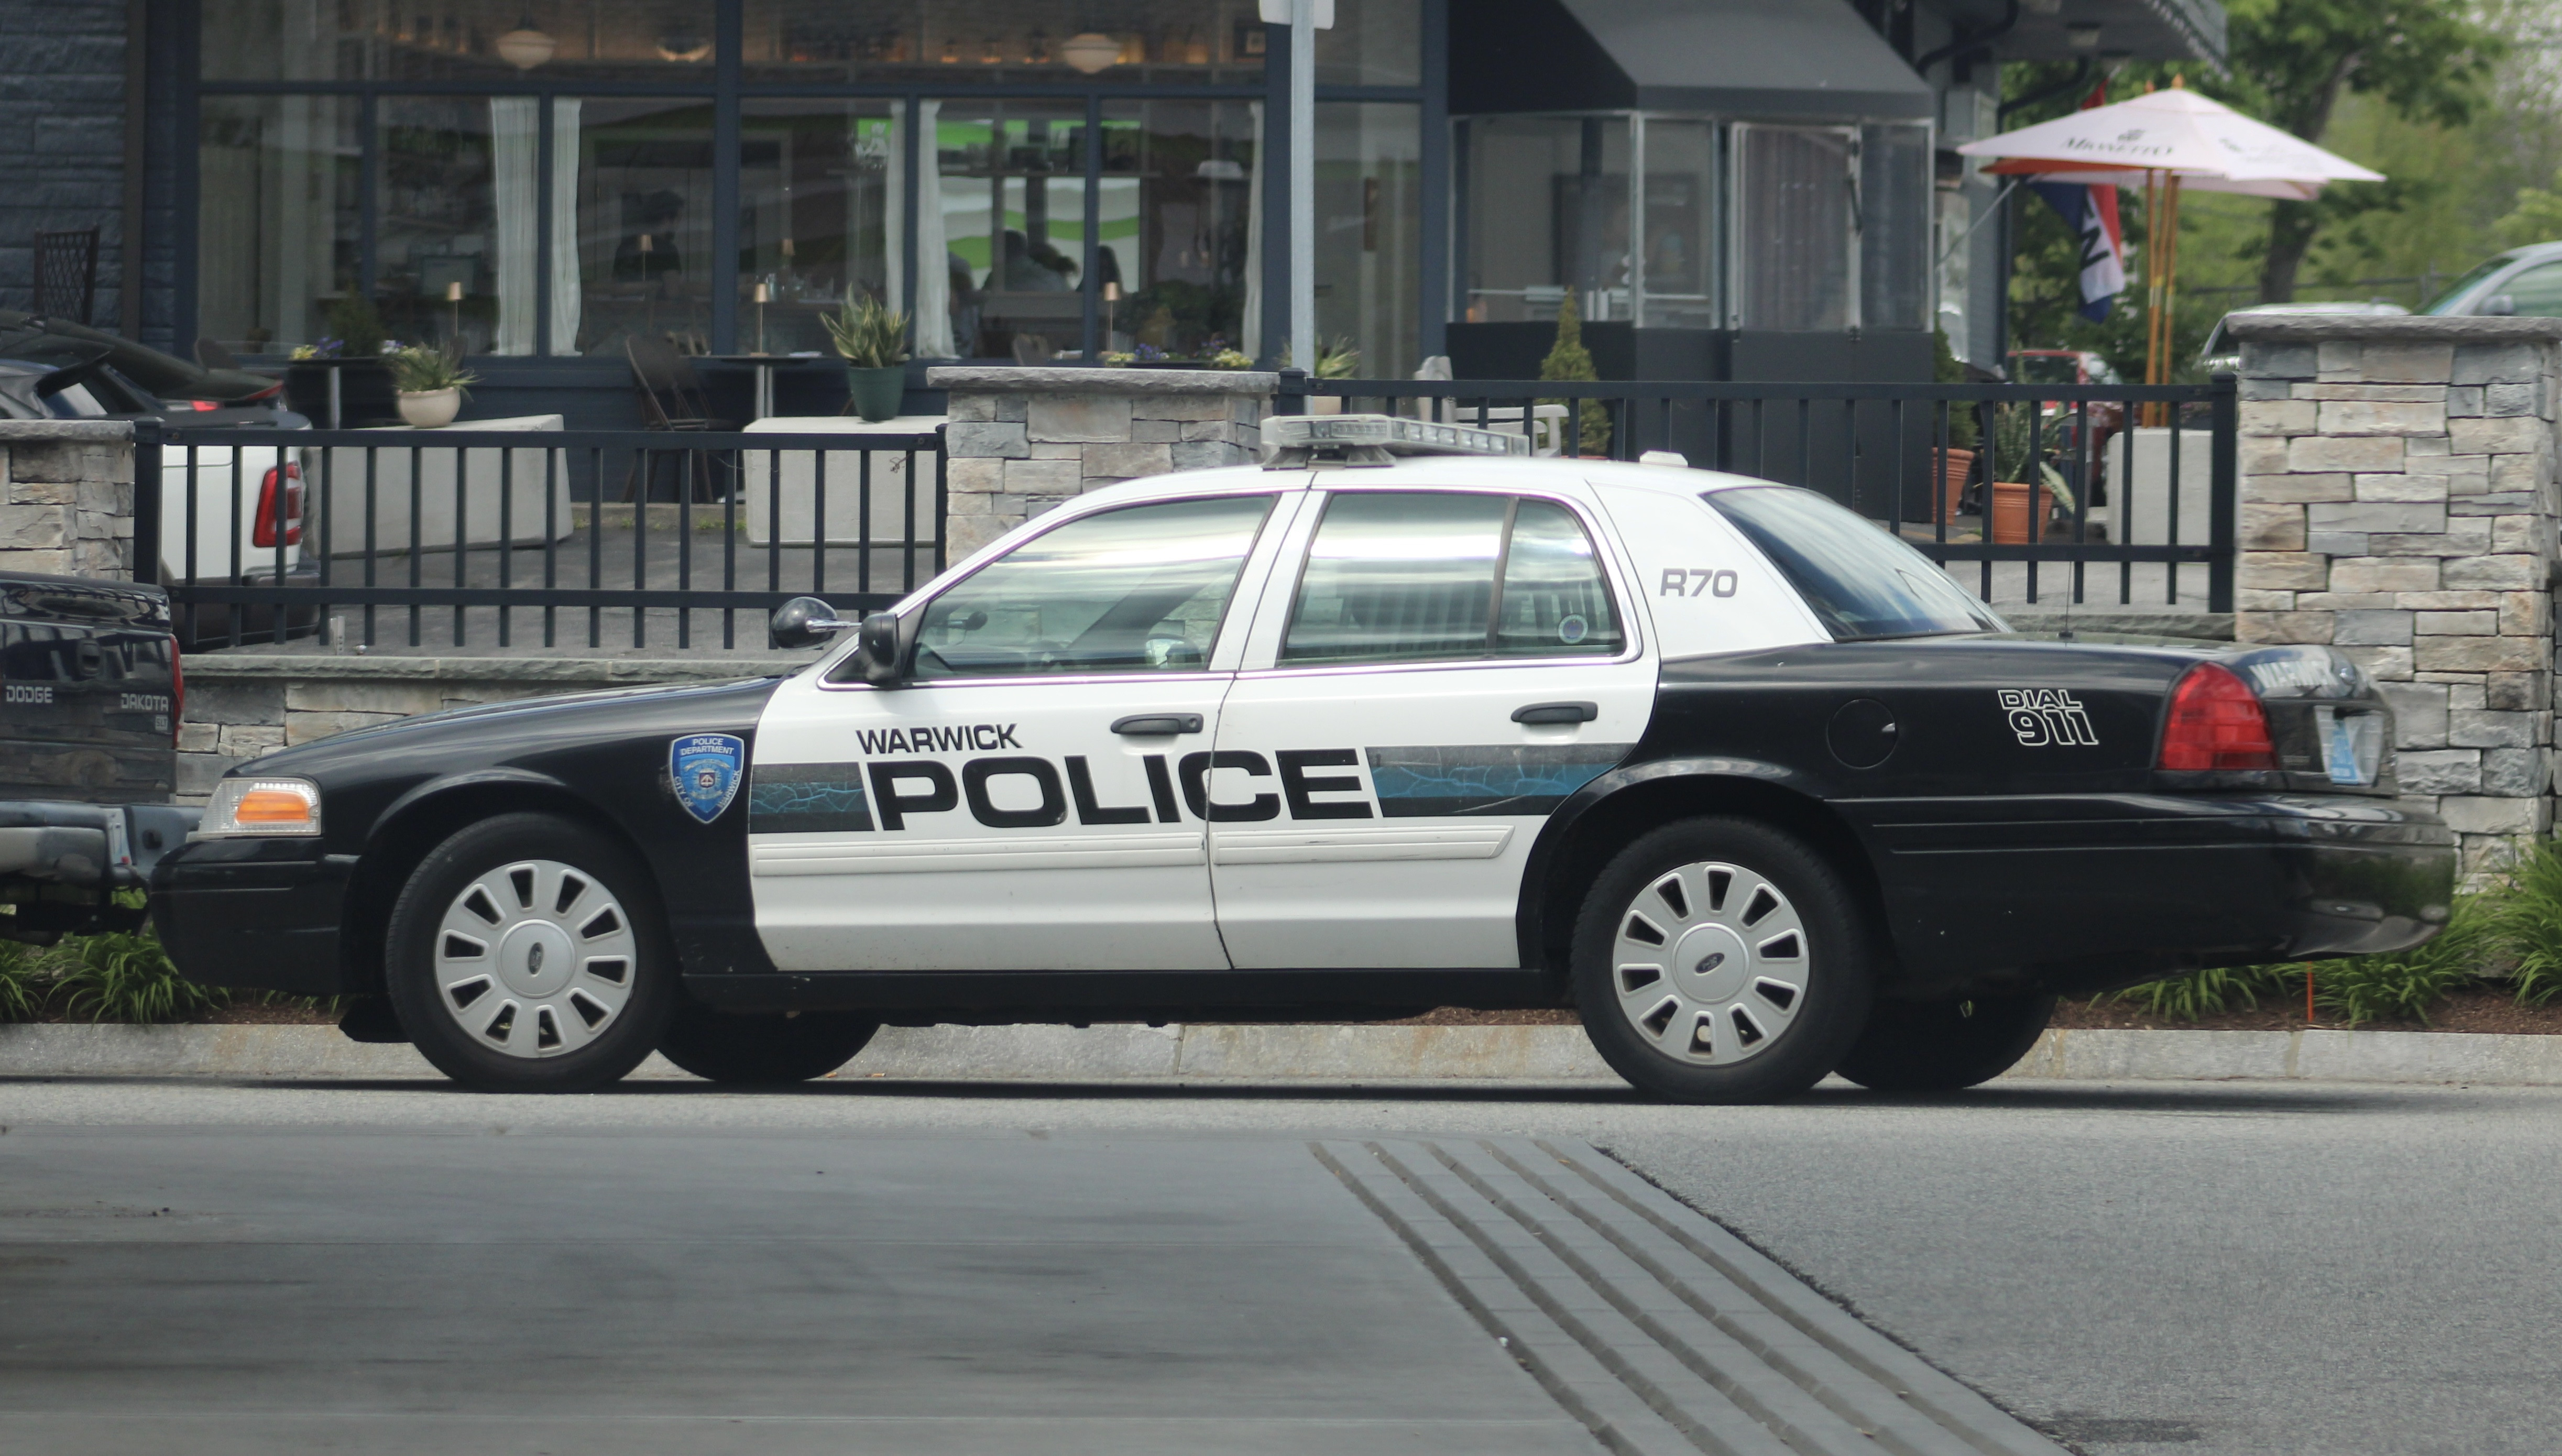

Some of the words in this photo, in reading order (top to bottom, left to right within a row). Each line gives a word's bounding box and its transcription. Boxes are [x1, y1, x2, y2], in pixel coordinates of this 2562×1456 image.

[1660, 568, 1738, 598] R70
[6, 685, 52, 703] DODGE
[121, 693, 168, 711] DAKOTA
[1998, 689, 2083, 710] DIAL
[2009, 708, 2099, 746] 911
[856, 723, 1024, 754] WARWICK
[680, 746, 735, 756] DEPARTMENT
[674, 776, 686, 794] CITY
[867, 748, 1374, 830] POLICE
